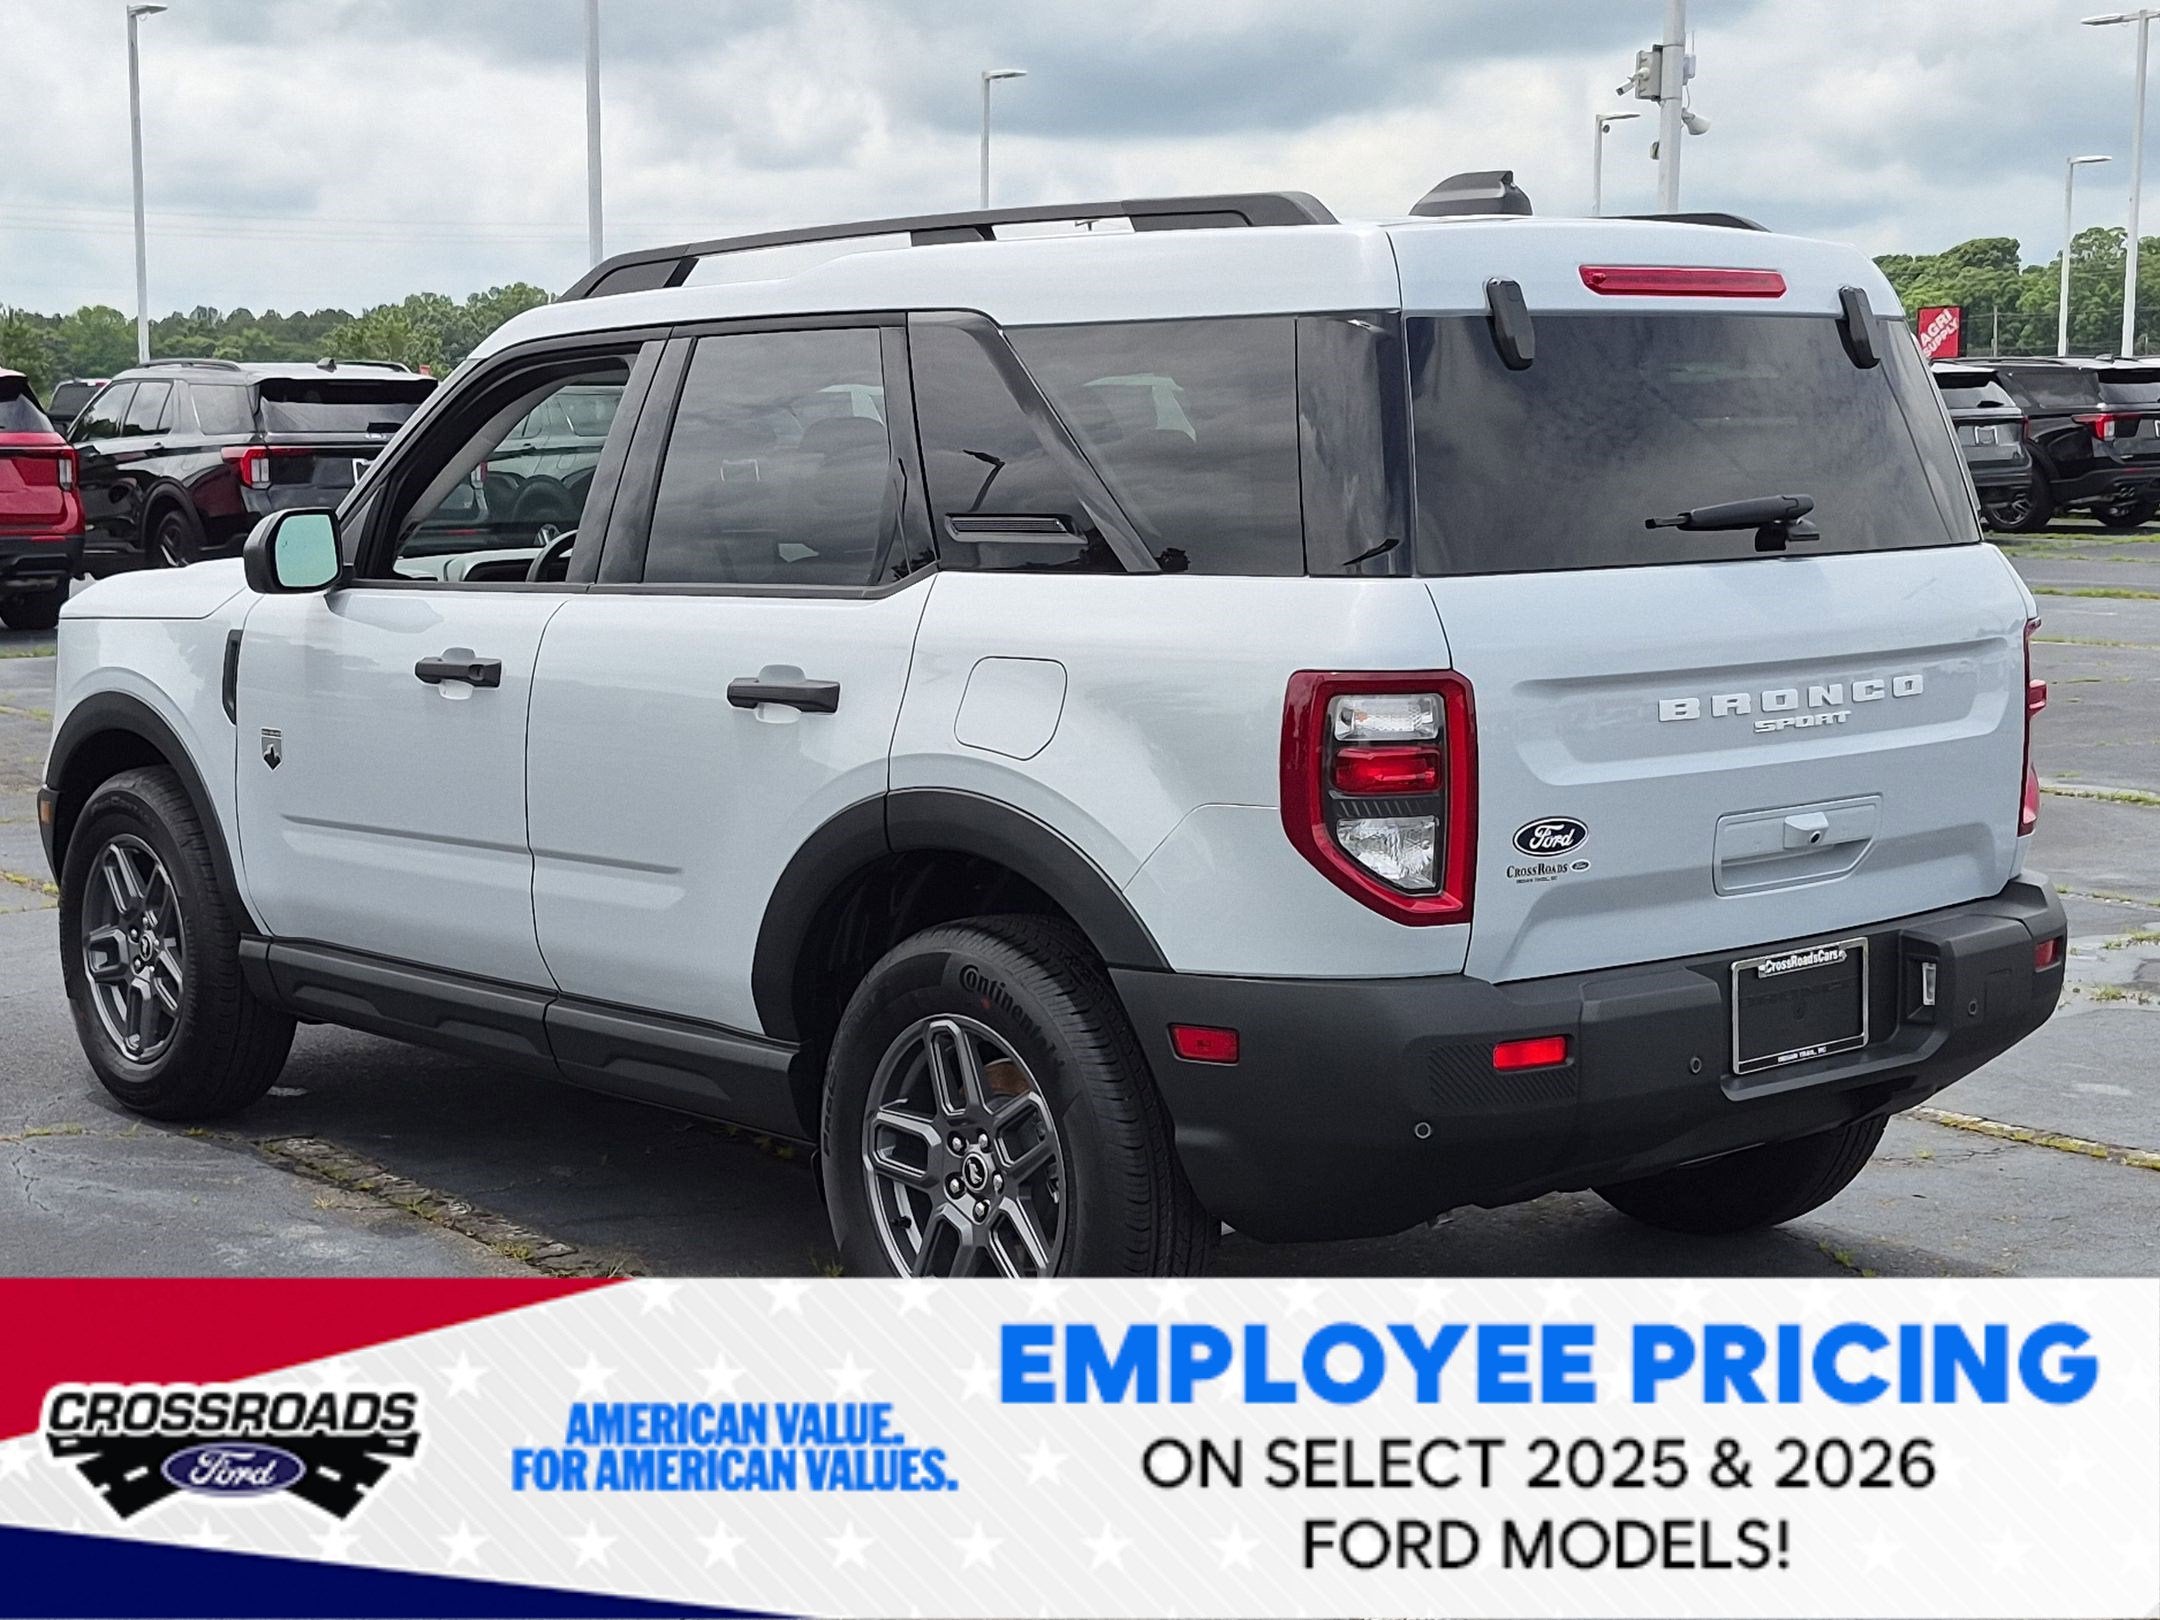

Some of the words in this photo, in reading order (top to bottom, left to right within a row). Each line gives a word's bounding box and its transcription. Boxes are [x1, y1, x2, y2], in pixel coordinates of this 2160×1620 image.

[1920, 308, 1953, 347] AGRI
[1922, 317, 1960, 358] SUPPLY
[1657, 673, 1924, 722] BRONCO
[1753, 710, 1852, 733] SPORT
[1528, 823, 1576, 850] Ford
[958, 963, 1058, 1053] Continen
